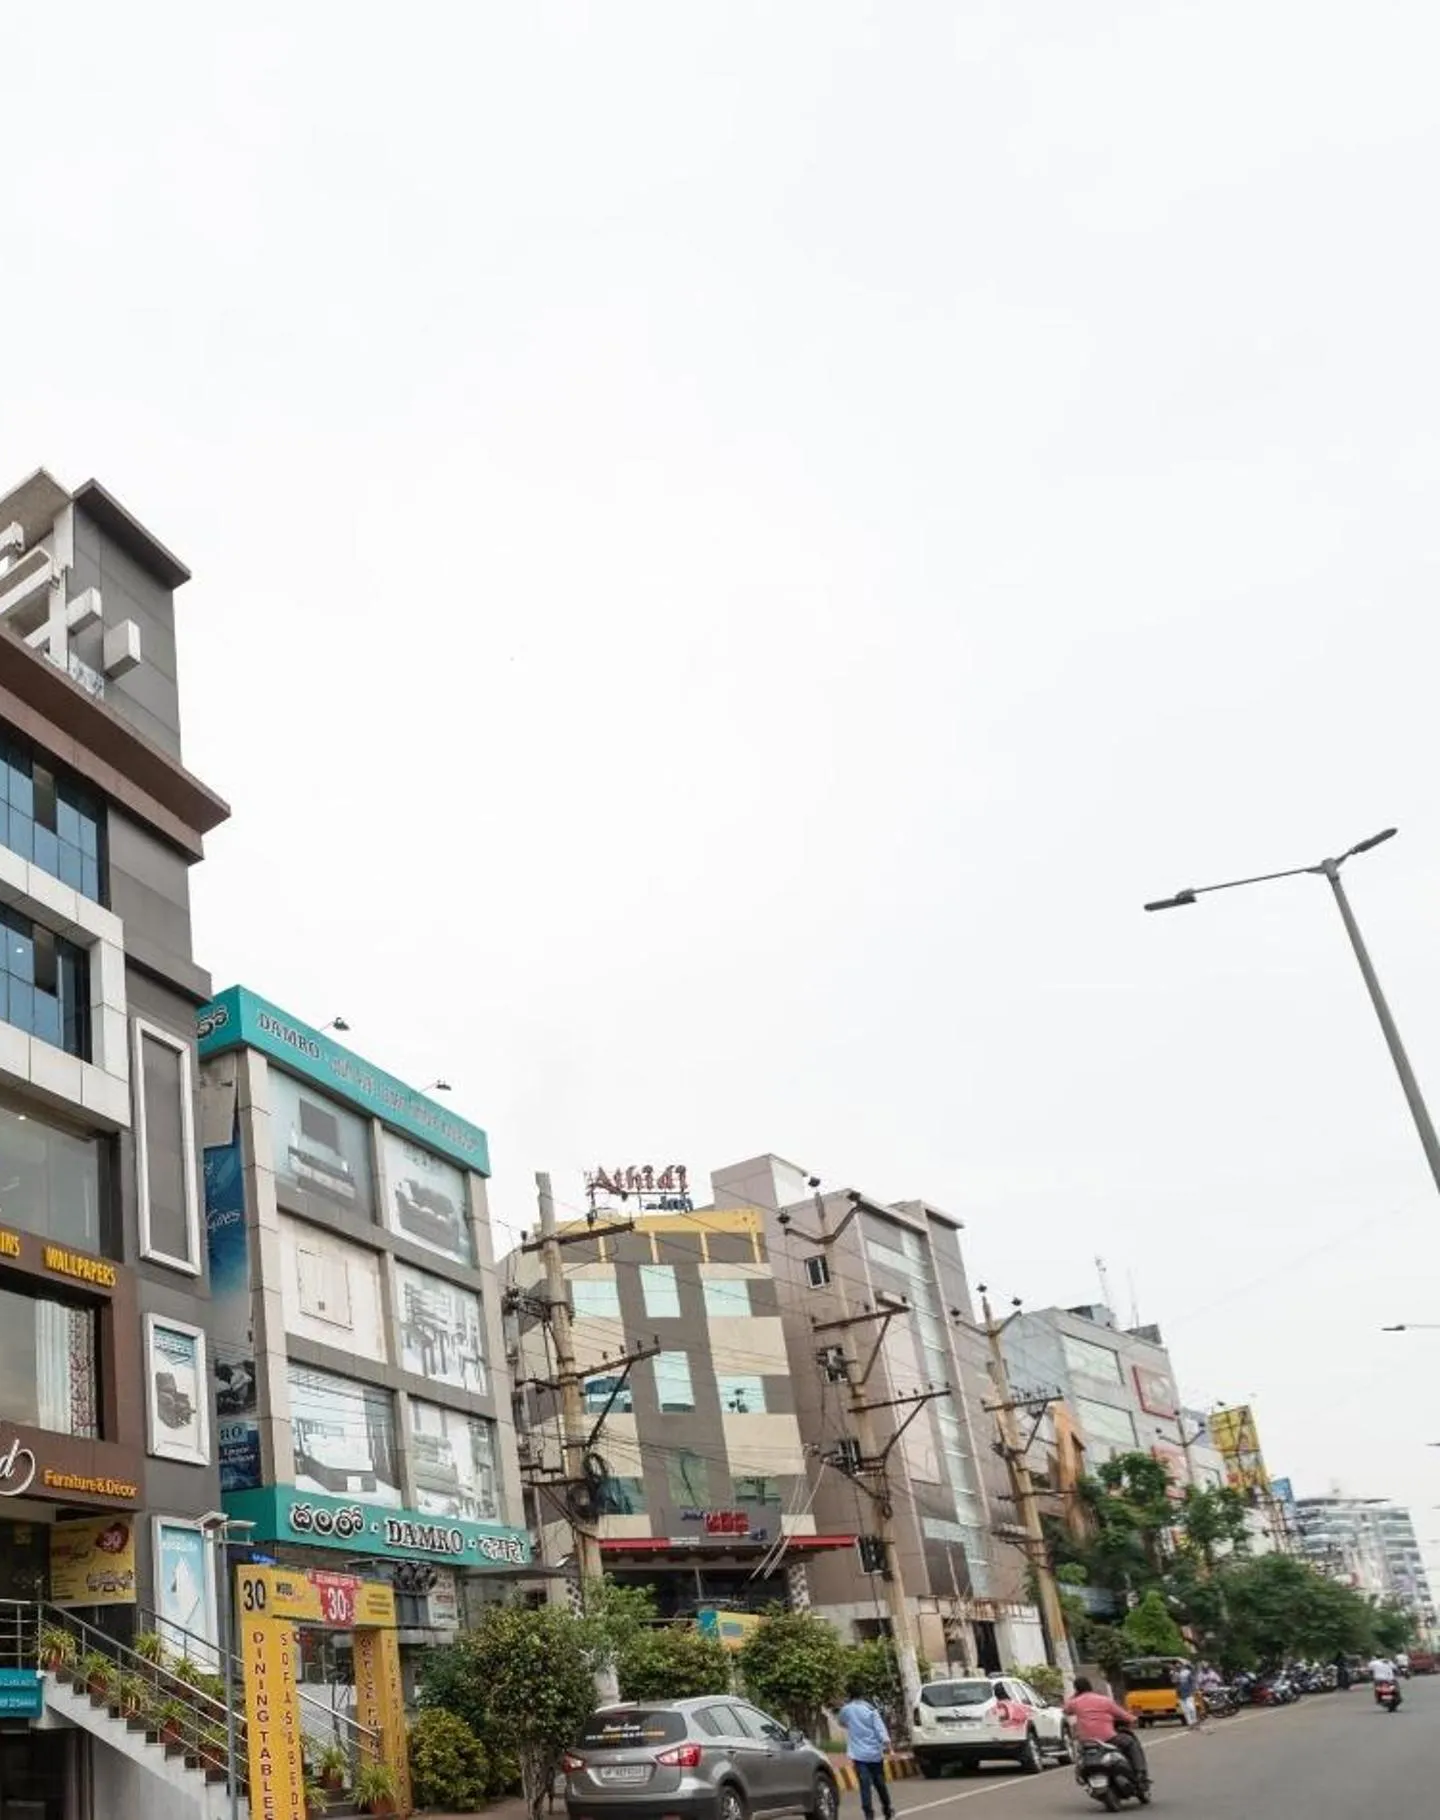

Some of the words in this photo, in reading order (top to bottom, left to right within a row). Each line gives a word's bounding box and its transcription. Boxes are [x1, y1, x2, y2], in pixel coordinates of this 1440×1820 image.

[257, 1012, 320, 1060] DAMRO
[45, 1245, 117, 1288] WALLPAPERS
[385, 1517, 465, 1555] DAMRO
[243, 1577, 267, 1612] 30
[326, 1586, 348, 1621] 30
[252, 1630, 270, 1724] DINING
[279, 1633, 294, 1726] SOFAS
[260, 1730, 276, 1820] TABLES
